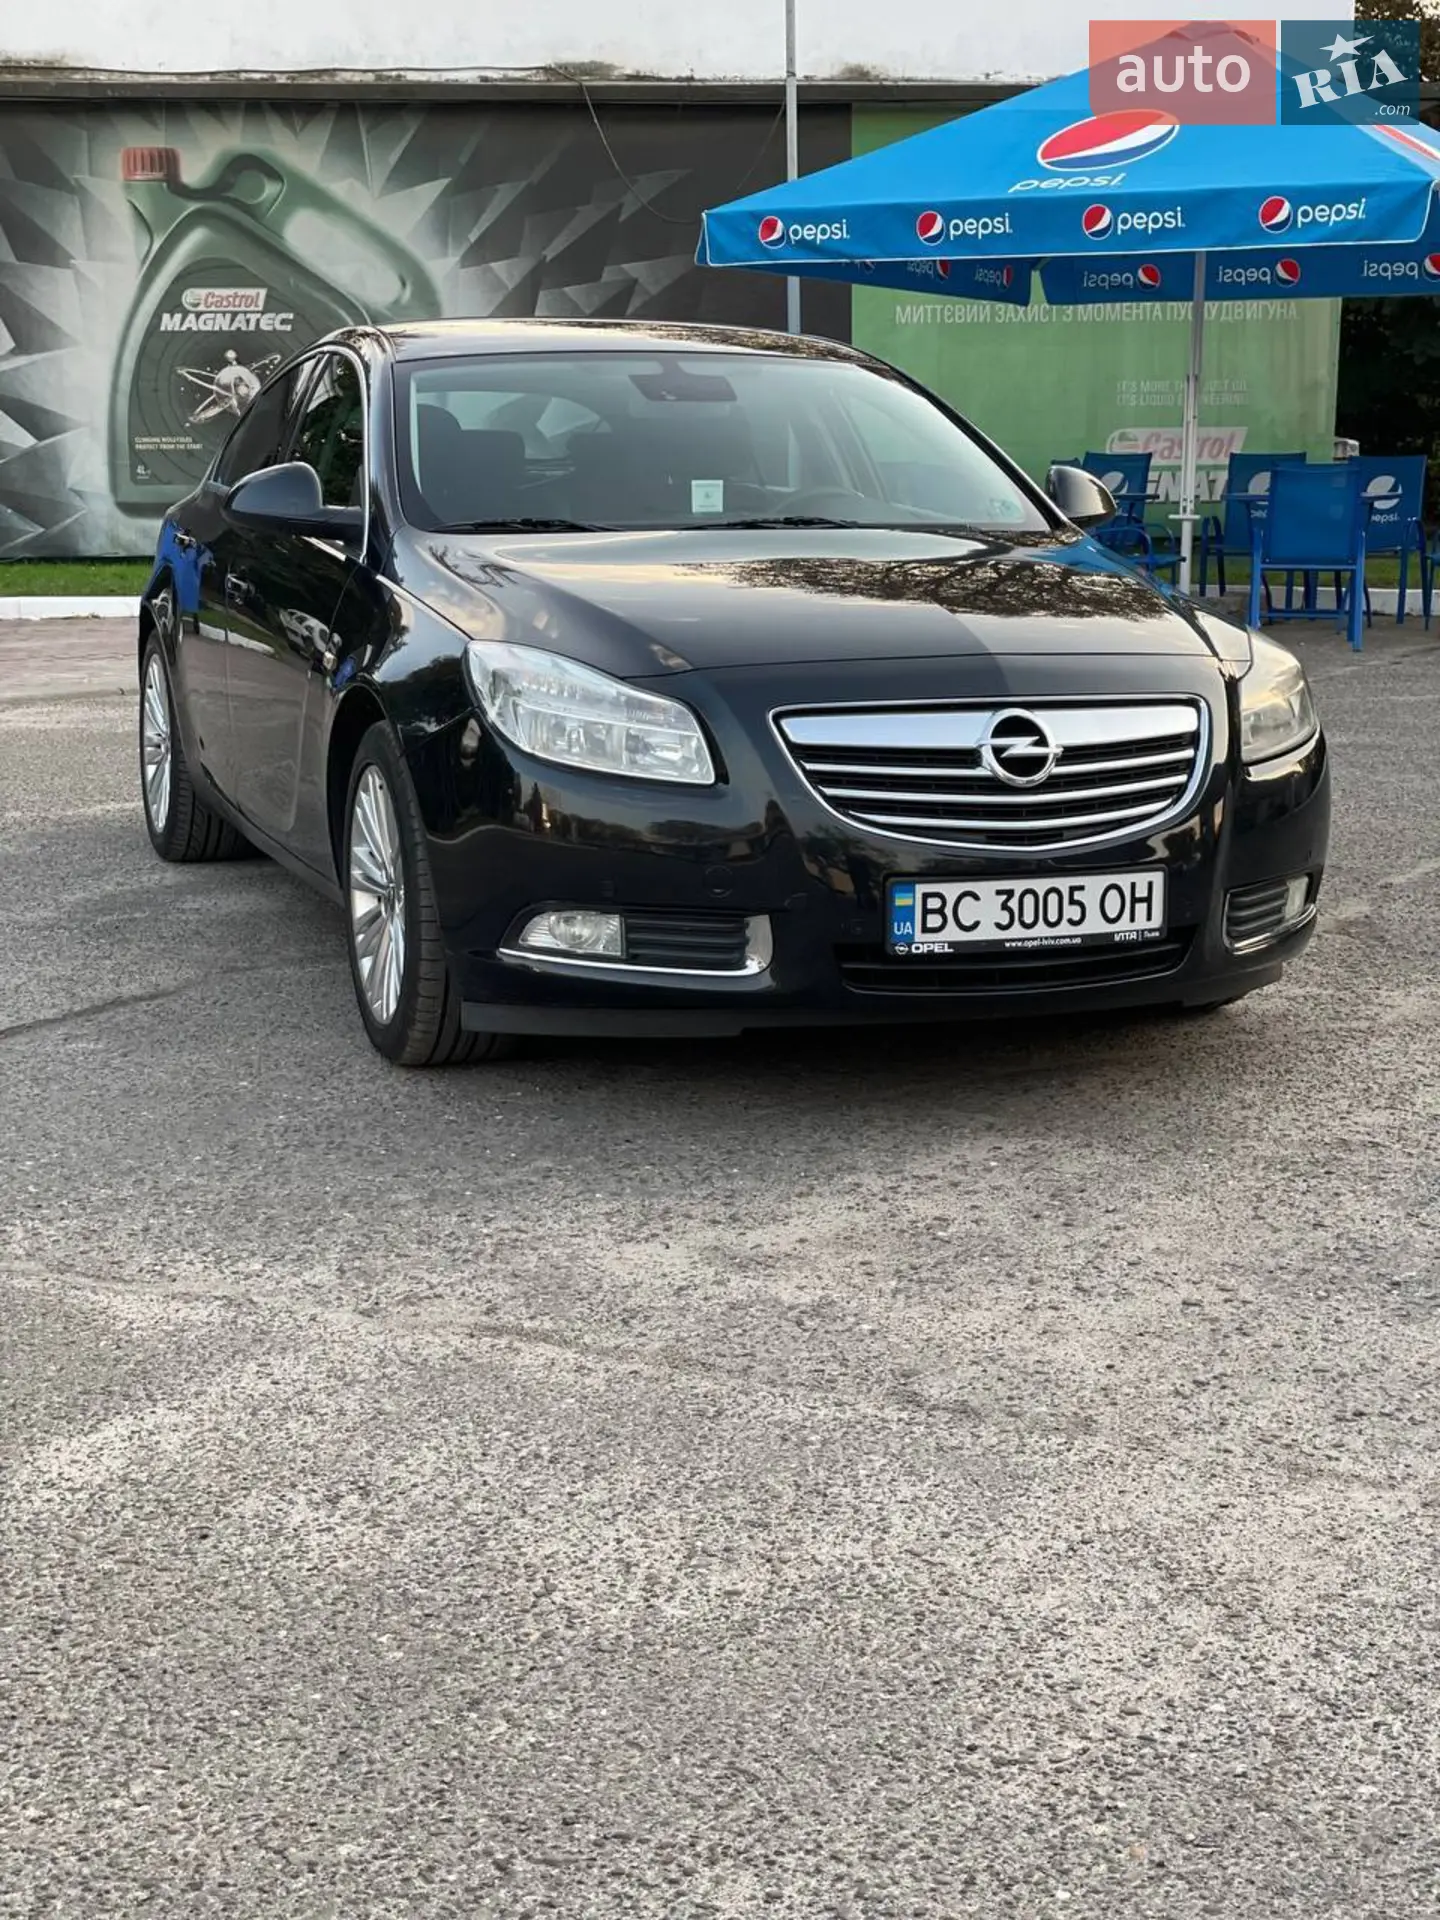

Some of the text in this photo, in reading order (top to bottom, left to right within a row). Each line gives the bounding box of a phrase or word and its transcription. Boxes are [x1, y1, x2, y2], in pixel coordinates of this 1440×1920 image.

[1008, 173, 1126, 193] pepsi
[1117, 206, 1185, 234] pepsi
[1298, 198, 1366, 227] pepsi
[789, 219, 850, 244] pepsi
[949, 213, 1012, 239] pepsi
[204, 291, 261, 308] Castrol
[160, 312, 294, 332] MAGNATEC
[1220, 300, 1297, 322] ДВИГУНА
[921, 880, 1154, 934] BC 3005 OH
[894, 923, 912, 935] UA
[911, 937, 1081, 953] OPEL www.opel-lviv.com.ua
